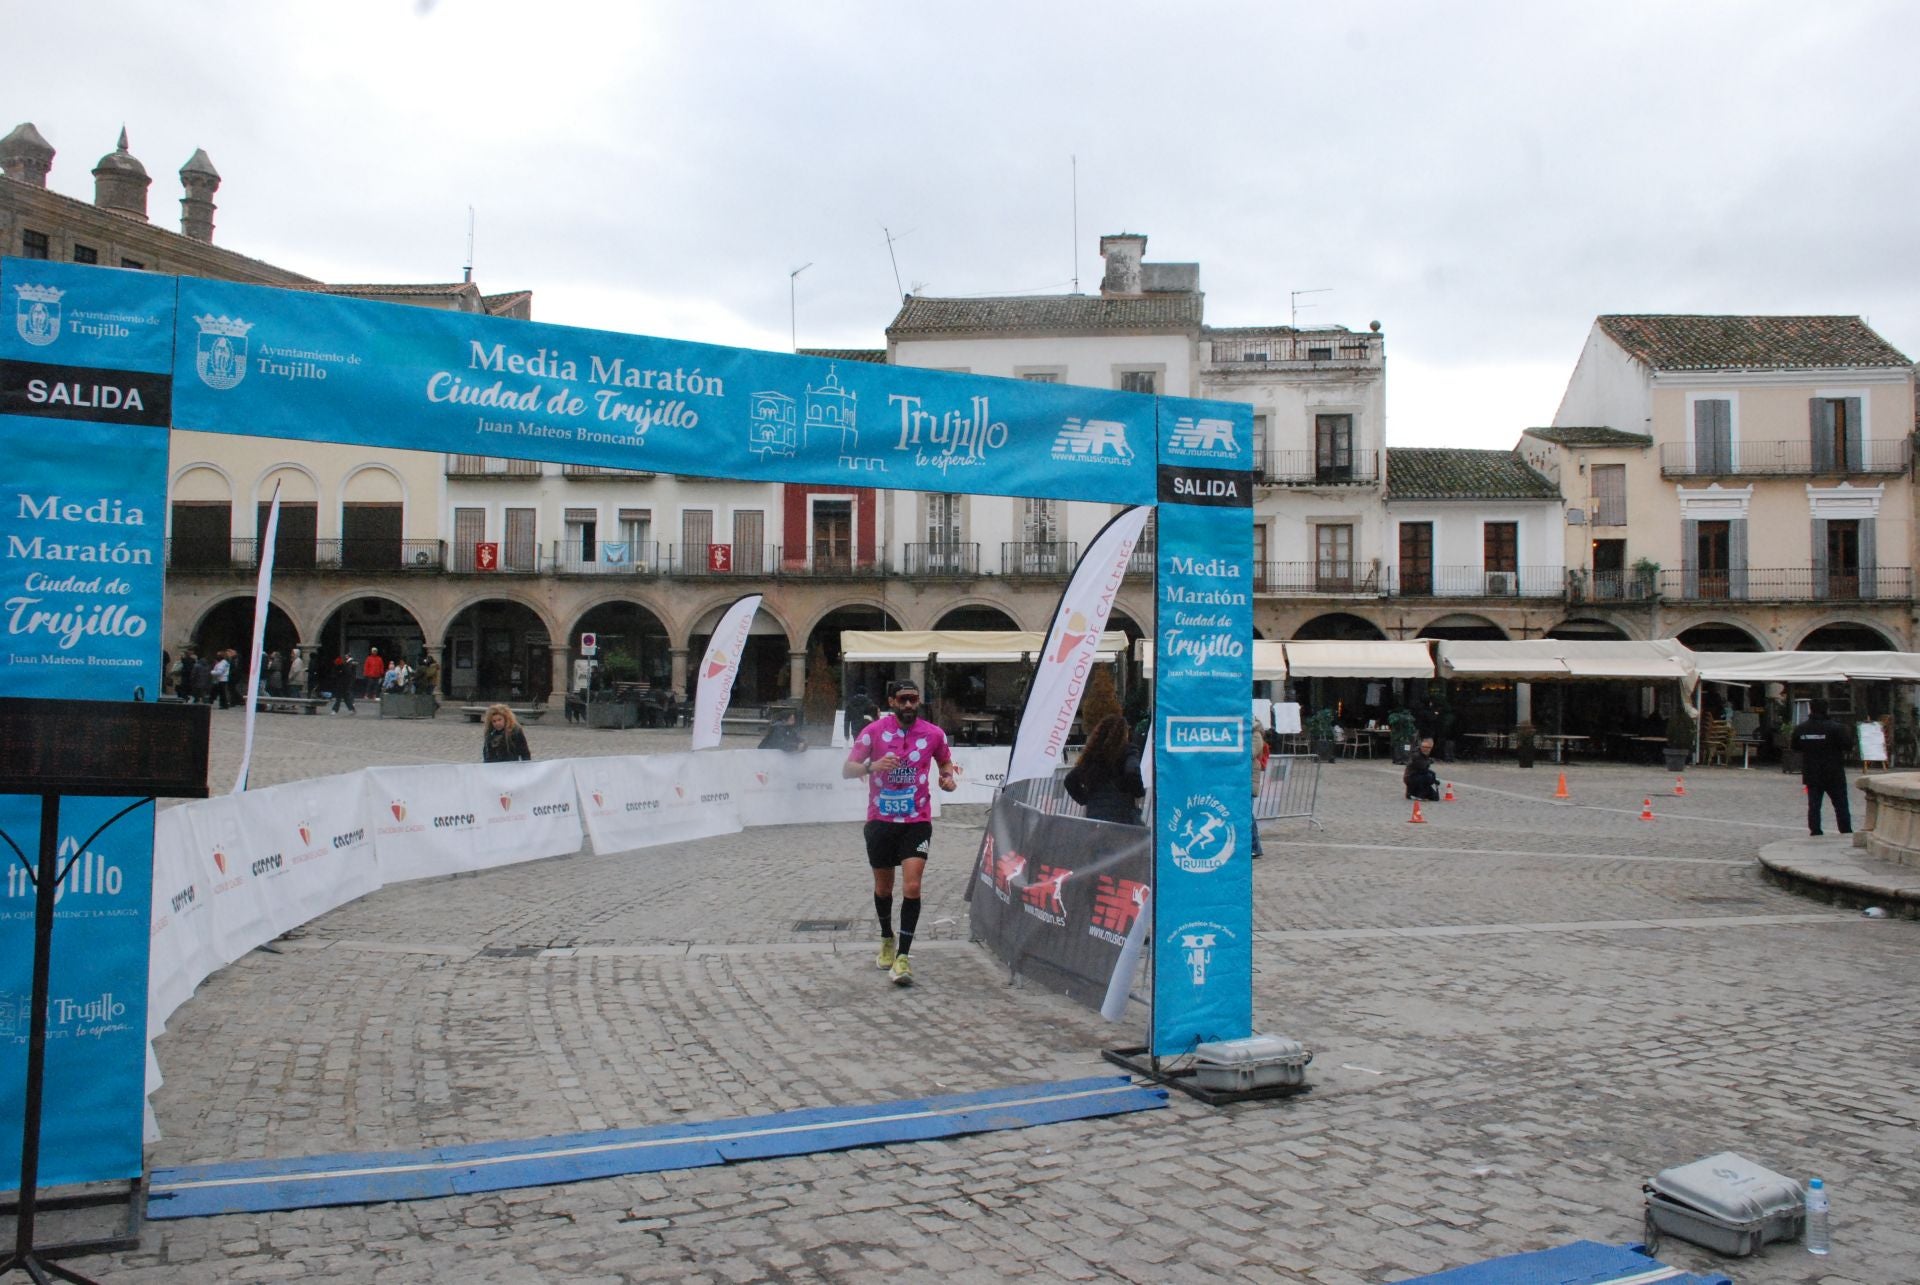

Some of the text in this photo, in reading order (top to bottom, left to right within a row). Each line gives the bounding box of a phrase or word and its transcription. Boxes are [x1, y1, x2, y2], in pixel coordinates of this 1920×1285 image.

[69, 308, 160, 326] Ayuntamiento de
[68, 320, 129, 338] Trujillo
[258, 343, 361, 365] Ayuntamiento de
[257, 359, 327, 381] Trujillo
[469, 340, 724, 397] Media Maratón
[27, 379, 144, 411] SALIDA
[427, 372, 698, 435] Ciudad de Trujillo
[476, 418, 644, 447] Juan Mateos Broncano
[889, 393, 1008, 459] Trujillo
[915, 445, 928, 466] te
[1050, 453, 1132, 467] www.musicrun.es
[1173, 477, 1238, 497] SALIDA
[17, 493, 144, 527] Media
[7, 535, 152, 565] Maratón
[1170, 556, 1240, 577] Media
[25, 572, 131, 595] Ciudad de
[1166, 585, 1247, 605] Maratón
[5, 596, 147, 650] Trujillo
[1175, 611, 1232, 627] Ciudad de
[1165, 629, 1243, 666] Trujillo
[9, 653, 143, 667] Juan Mateos Broncano
[1167, 668, 1183, 678] Juan
[1044, 651, 1091, 758] DIPUTACIÓN
[1086, 623, 1101, 647] DE
[1176, 727, 1232, 742] HABLA
[884, 800, 909, 812] 535
[1168, 793, 1230, 832] Club Atletismo
[14, 911, 35, 919] QUE
[93, 910, 104, 918] LA
[1187, 950, 1211, 965] A J
[1196, 965, 1202, 977] S
[54, 993, 125, 1024] Trujillo
